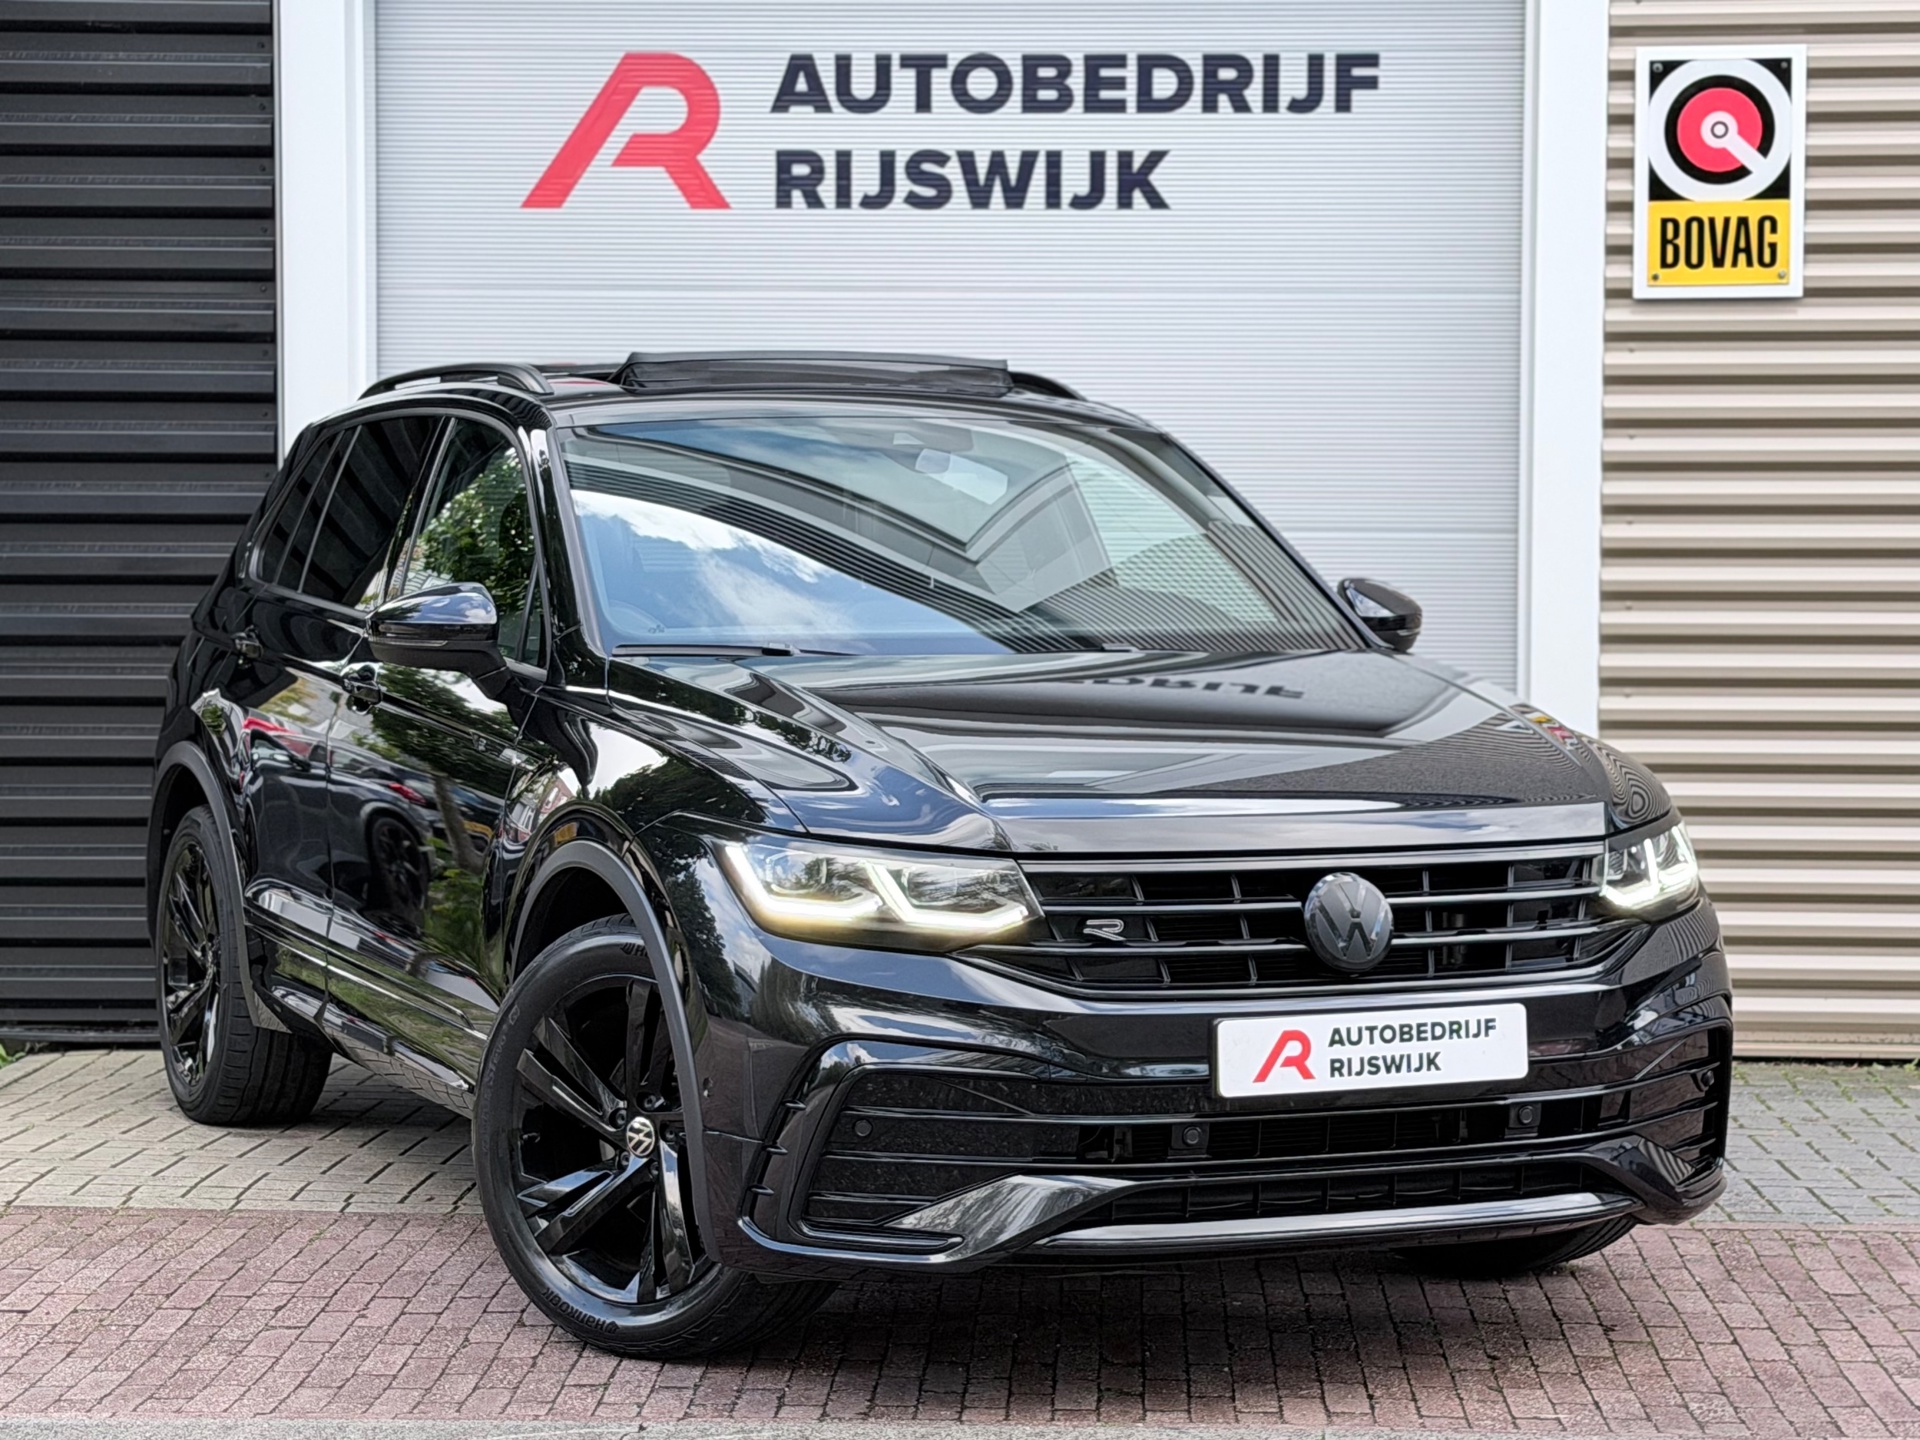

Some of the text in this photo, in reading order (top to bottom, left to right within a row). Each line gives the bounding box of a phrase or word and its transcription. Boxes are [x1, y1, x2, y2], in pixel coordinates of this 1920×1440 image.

[771, 53, 1380, 114] AUTOBEDRIJF
[776, 149, 1171, 210] RIJSWIJK
[1659, 215, 1778, 270] BOVAG
[1327, 1017, 1497, 1048] AUTOBEDRIJF
[1329, 1051, 1442, 1078] RIJSWIJK
